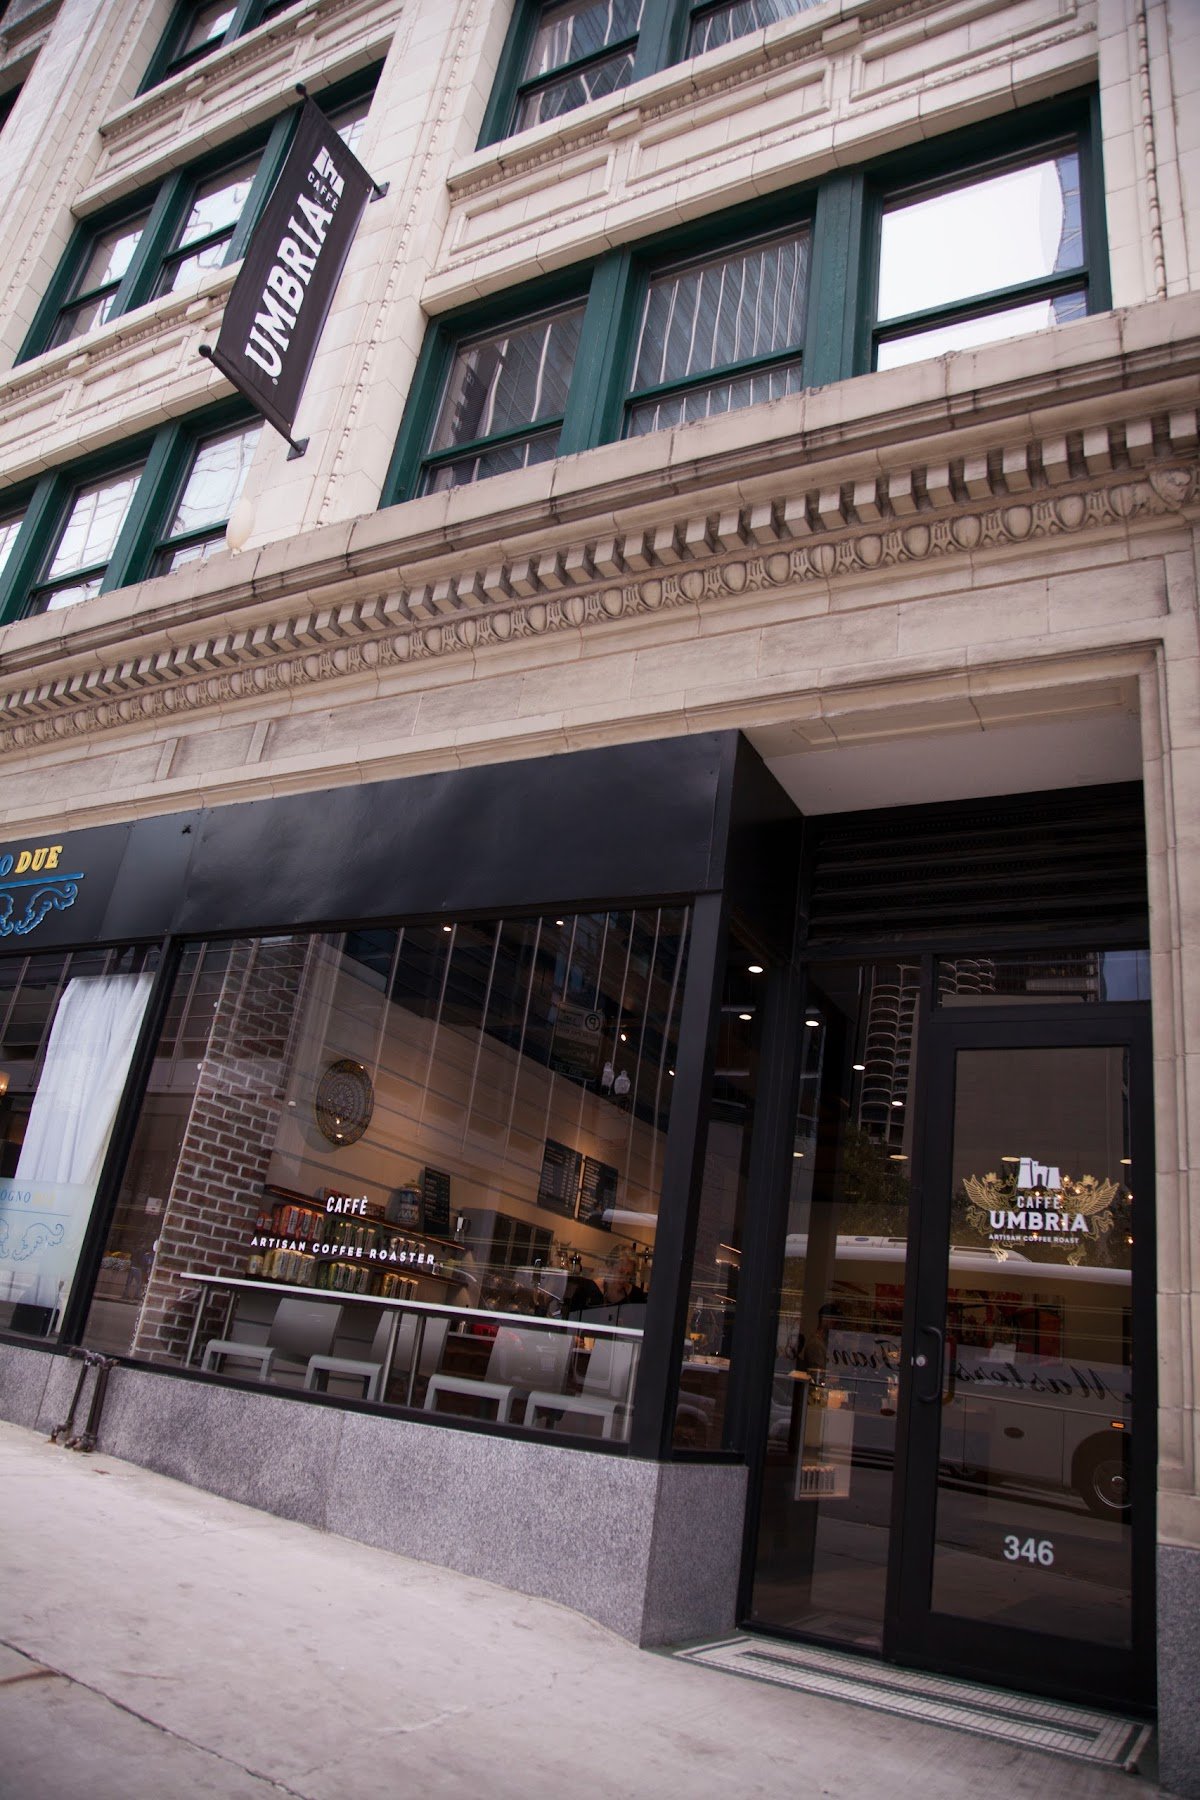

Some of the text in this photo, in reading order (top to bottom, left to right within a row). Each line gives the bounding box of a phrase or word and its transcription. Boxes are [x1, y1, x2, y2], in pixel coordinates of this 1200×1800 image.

[307, 171, 338, 211] CAFFÈ
[244, 193, 334, 378] UMBRIA
[14, 845, 64, 874] DUE
[326, 1195, 369, 1216] CAFFÈ
[989, 1210, 1089, 1232] UMBRIA
[250, 1236, 435, 1265] ARTISAN COFFEE ROASTER
[988, 1234, 1021, 1242] ARTISAN
[1023, 1235, 1052, 1243] COFFEE
[1003, 1534, 1054, 1566] 346
